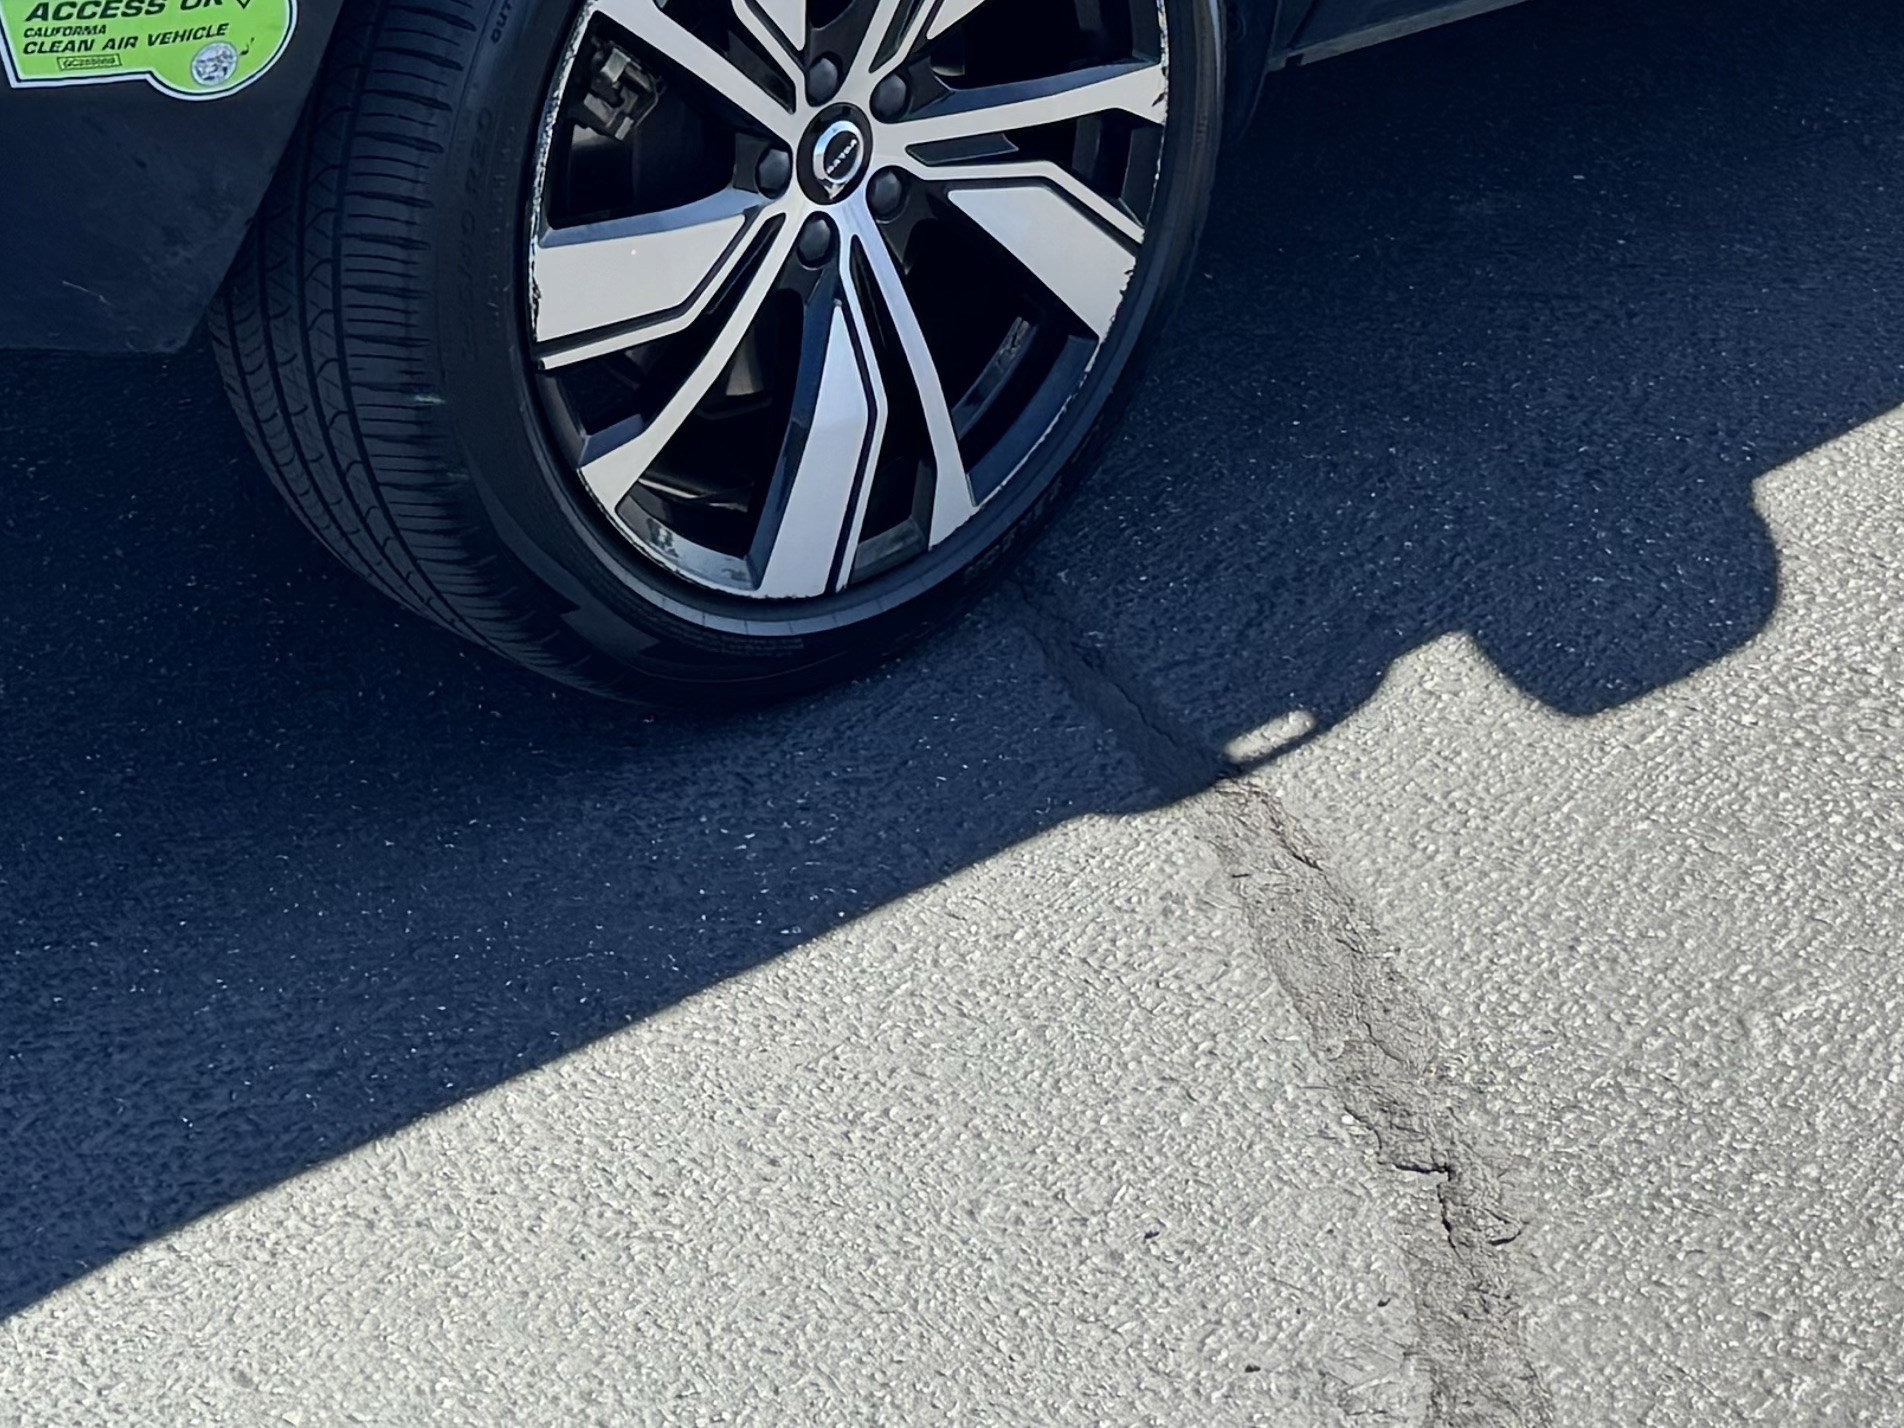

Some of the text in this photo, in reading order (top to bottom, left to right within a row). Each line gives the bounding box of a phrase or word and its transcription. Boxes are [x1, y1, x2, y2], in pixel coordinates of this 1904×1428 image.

[22, 23, 230, 55] CLEAN AIR VEHICLE
